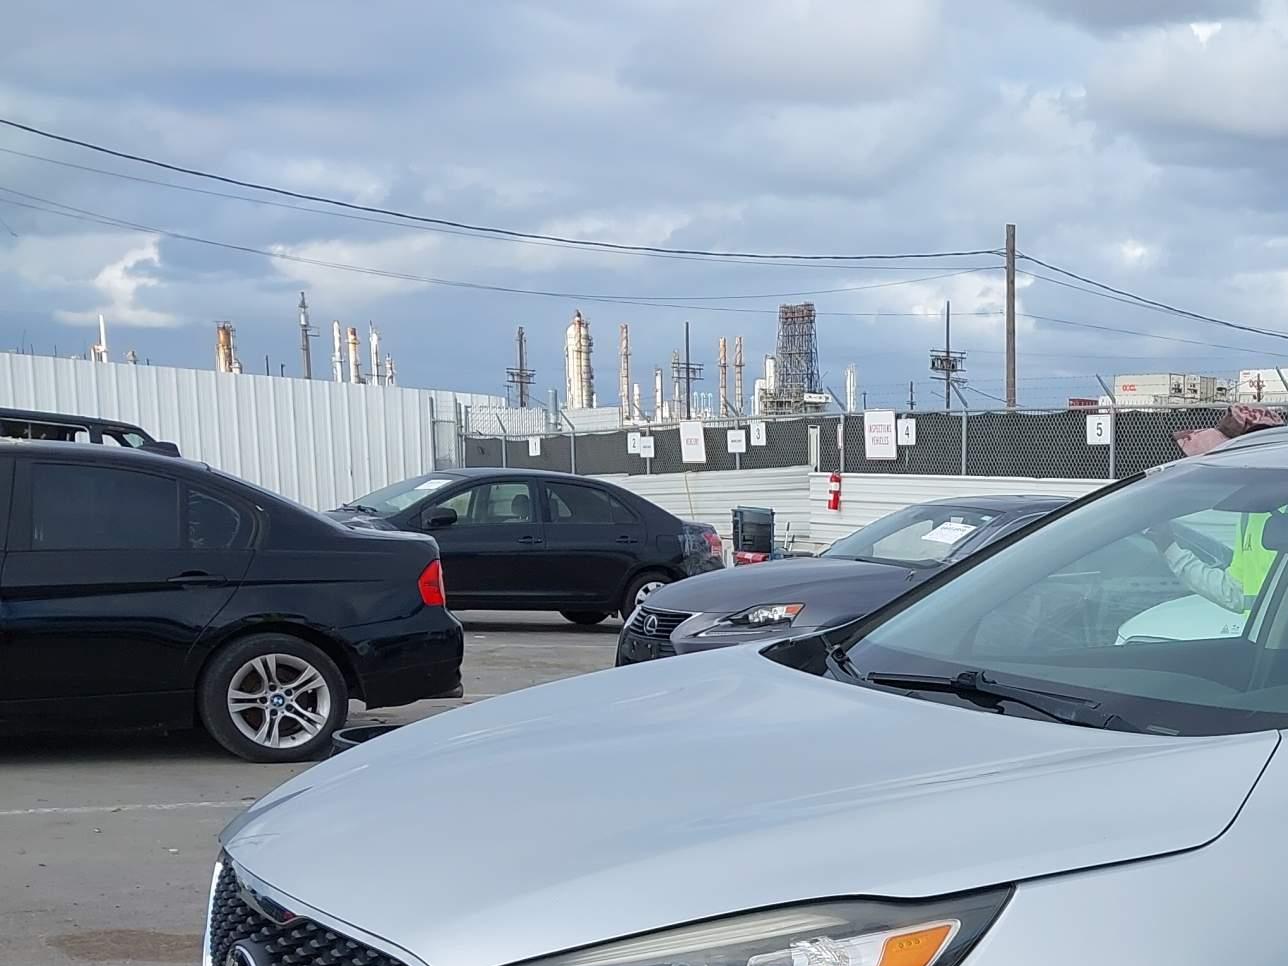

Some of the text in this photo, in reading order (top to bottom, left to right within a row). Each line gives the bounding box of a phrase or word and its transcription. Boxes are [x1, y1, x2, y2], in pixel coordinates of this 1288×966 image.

[755, 427, 761, 440] 3
[904, 425, 910, 438] 4
[1096, 423, 1103, 437] 5
